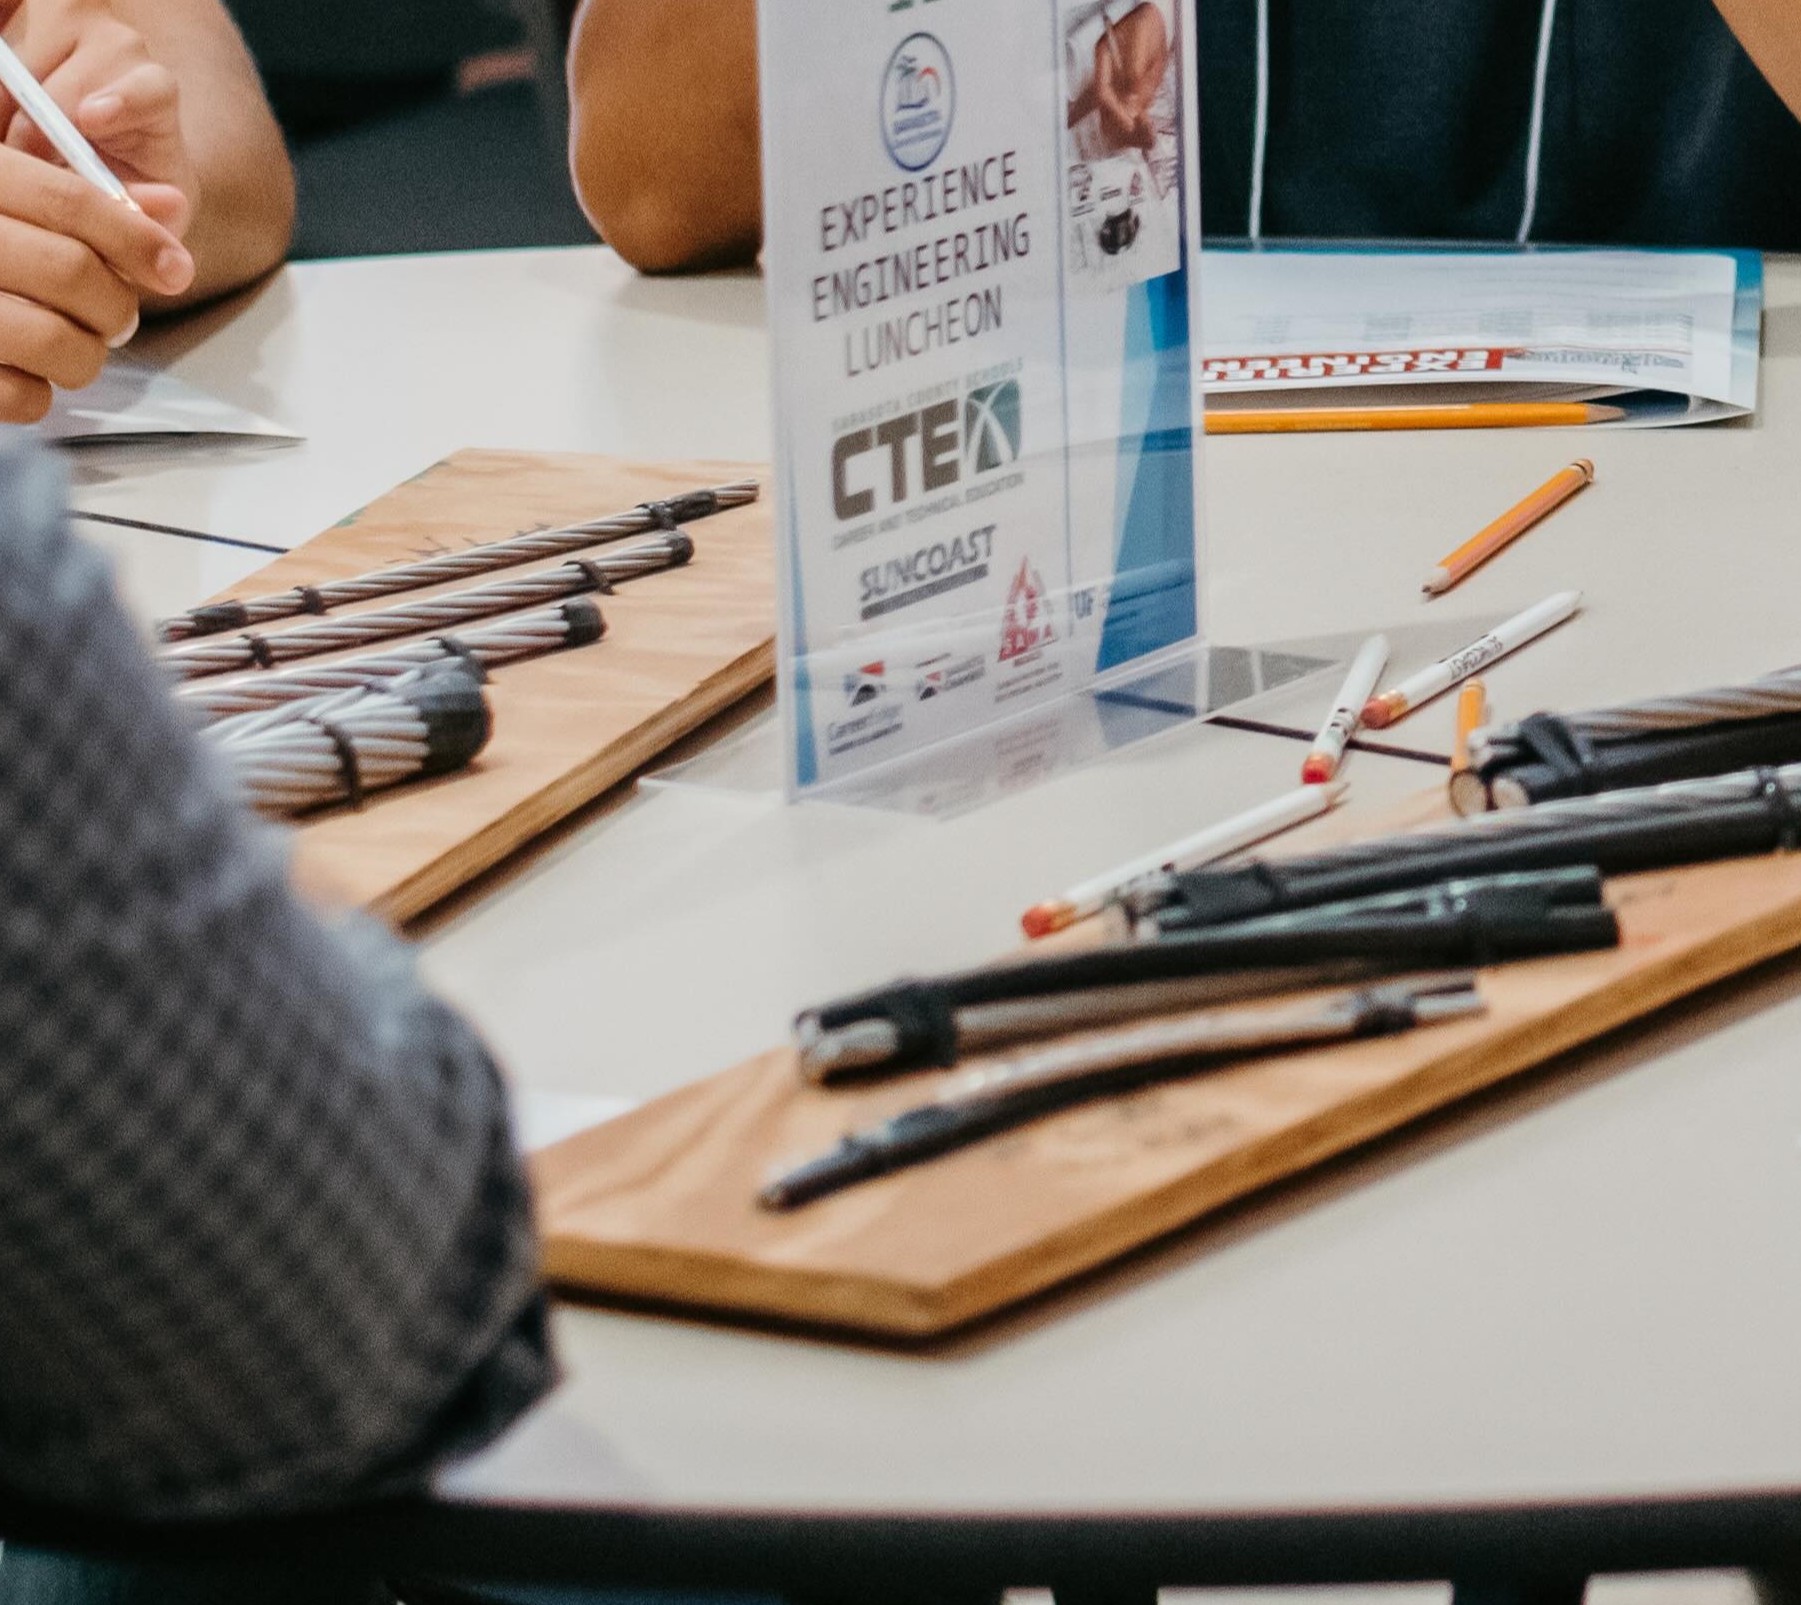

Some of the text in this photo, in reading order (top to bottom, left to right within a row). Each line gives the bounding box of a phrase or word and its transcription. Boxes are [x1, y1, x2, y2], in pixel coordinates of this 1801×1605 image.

[821, 151, 1018, 252] EXPERIENCE
[813, 216, 1031, 322] ENGINEERING
[844, 284, 1003, 378] LUNCHEON
[859, 523, 997, 602] SUNCOAST
